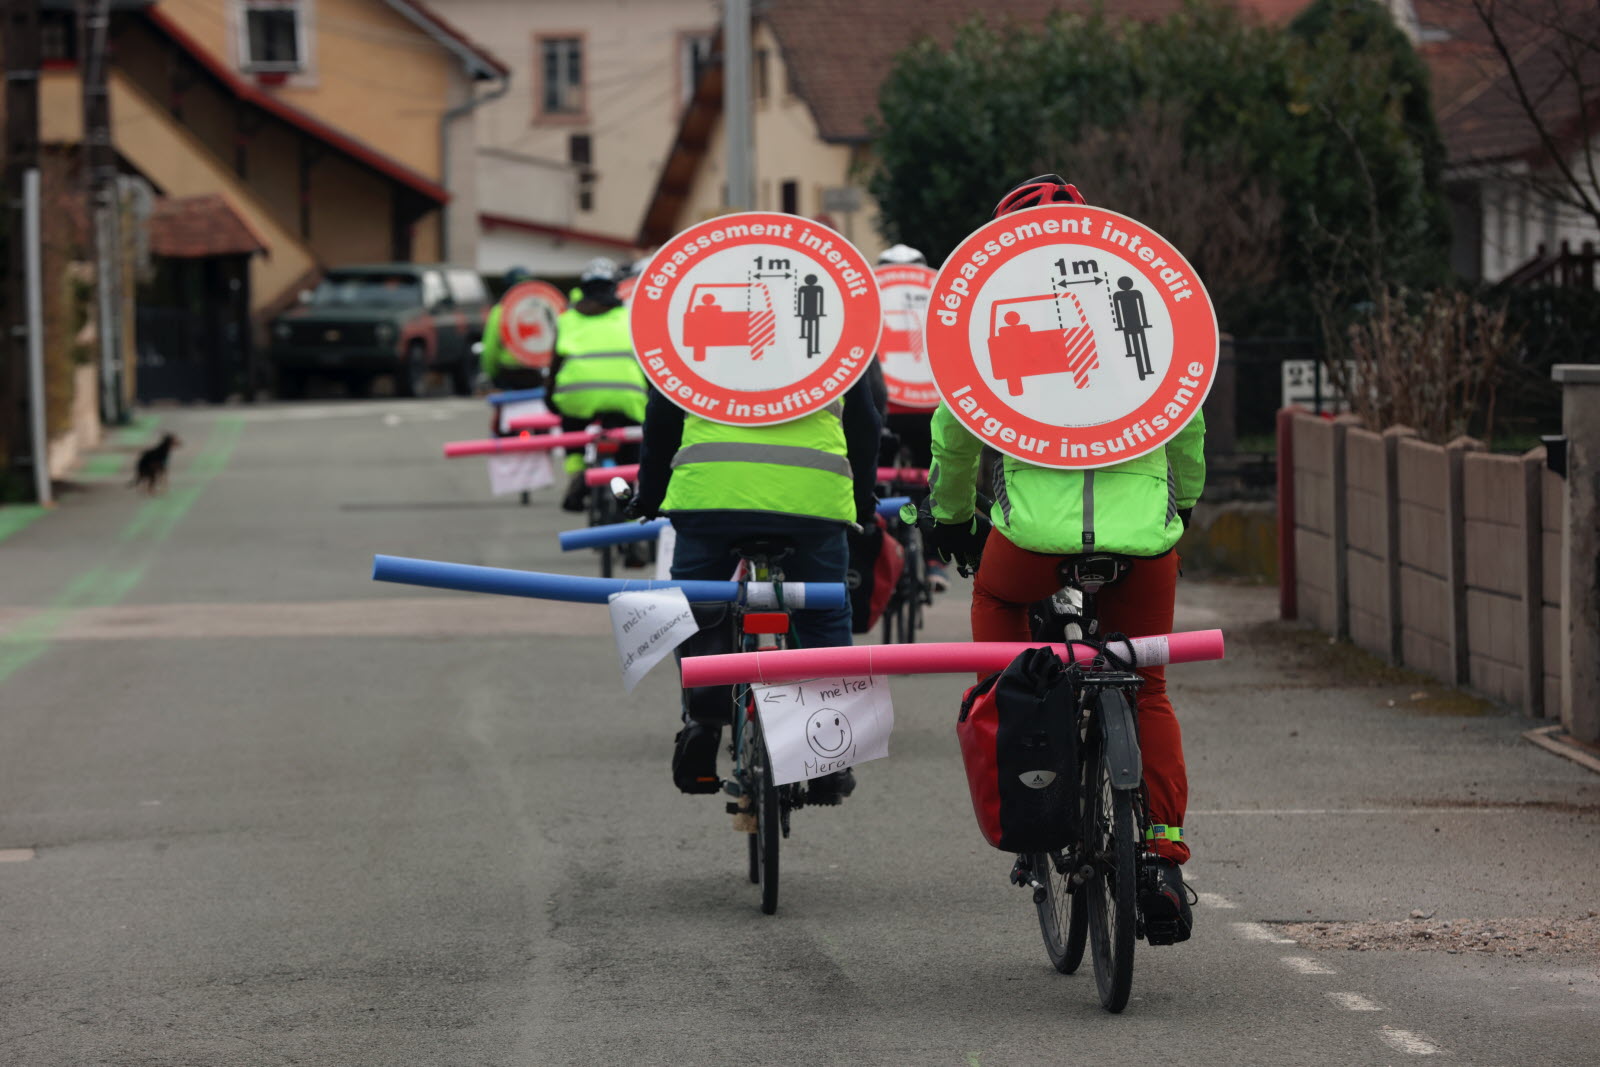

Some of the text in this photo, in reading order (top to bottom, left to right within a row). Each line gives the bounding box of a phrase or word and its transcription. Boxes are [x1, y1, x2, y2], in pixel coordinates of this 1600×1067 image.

[645, 223, 869, 301] dépassement interdit
[937, 216, 1194, 327] dépassement interdit
[644, 345, 865, 417] largeur insuffisante
[951, 360, 1205, 459] largeur insuffisante
